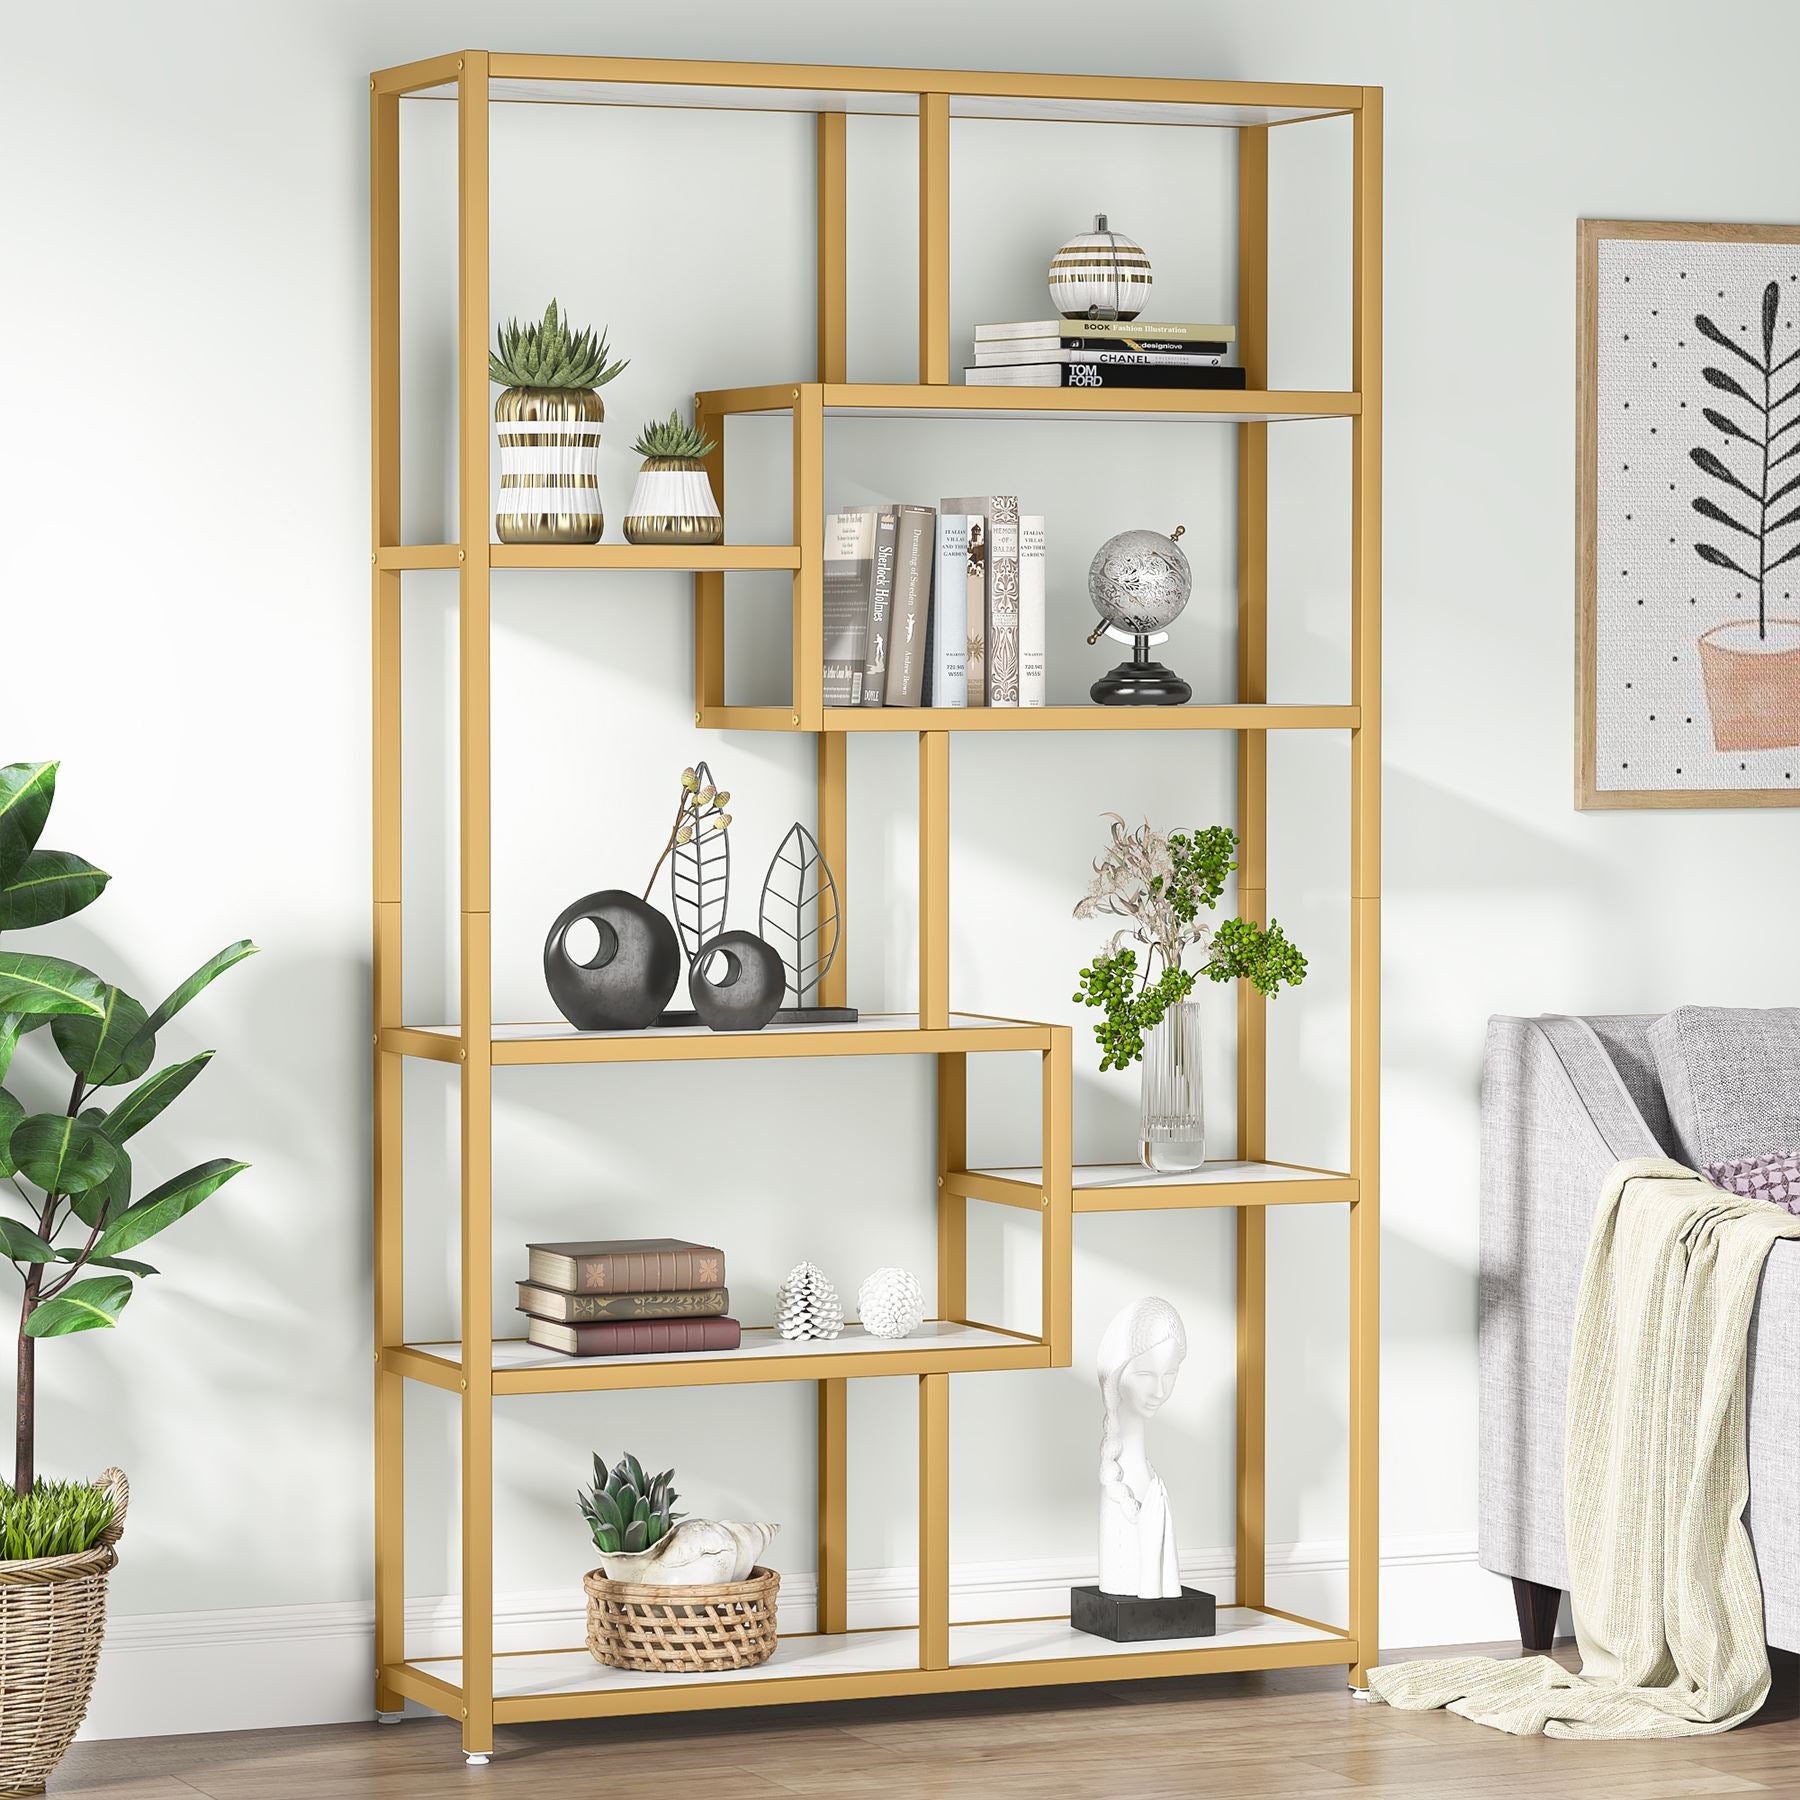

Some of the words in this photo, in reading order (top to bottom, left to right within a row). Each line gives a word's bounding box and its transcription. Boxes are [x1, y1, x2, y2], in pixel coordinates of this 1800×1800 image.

[1084, 323, 1110, 331] BOOK
[1145, 325, 1187, 334] Illustration
[1099, 353, 1151, 364] CHANEL
[1068, 364, 1097, 376] TOM
[1068, 375, 1103, 387] FORD
[909, 528, 922, 566] Dreaming
[876, 545, 893, 586] Sherlock
[910, 566, 919, 576] of
[907, 576, 918, 607] Sweden
[873, 588, 890, 622] Holmes
[902, 675, 910, 696] Brown
